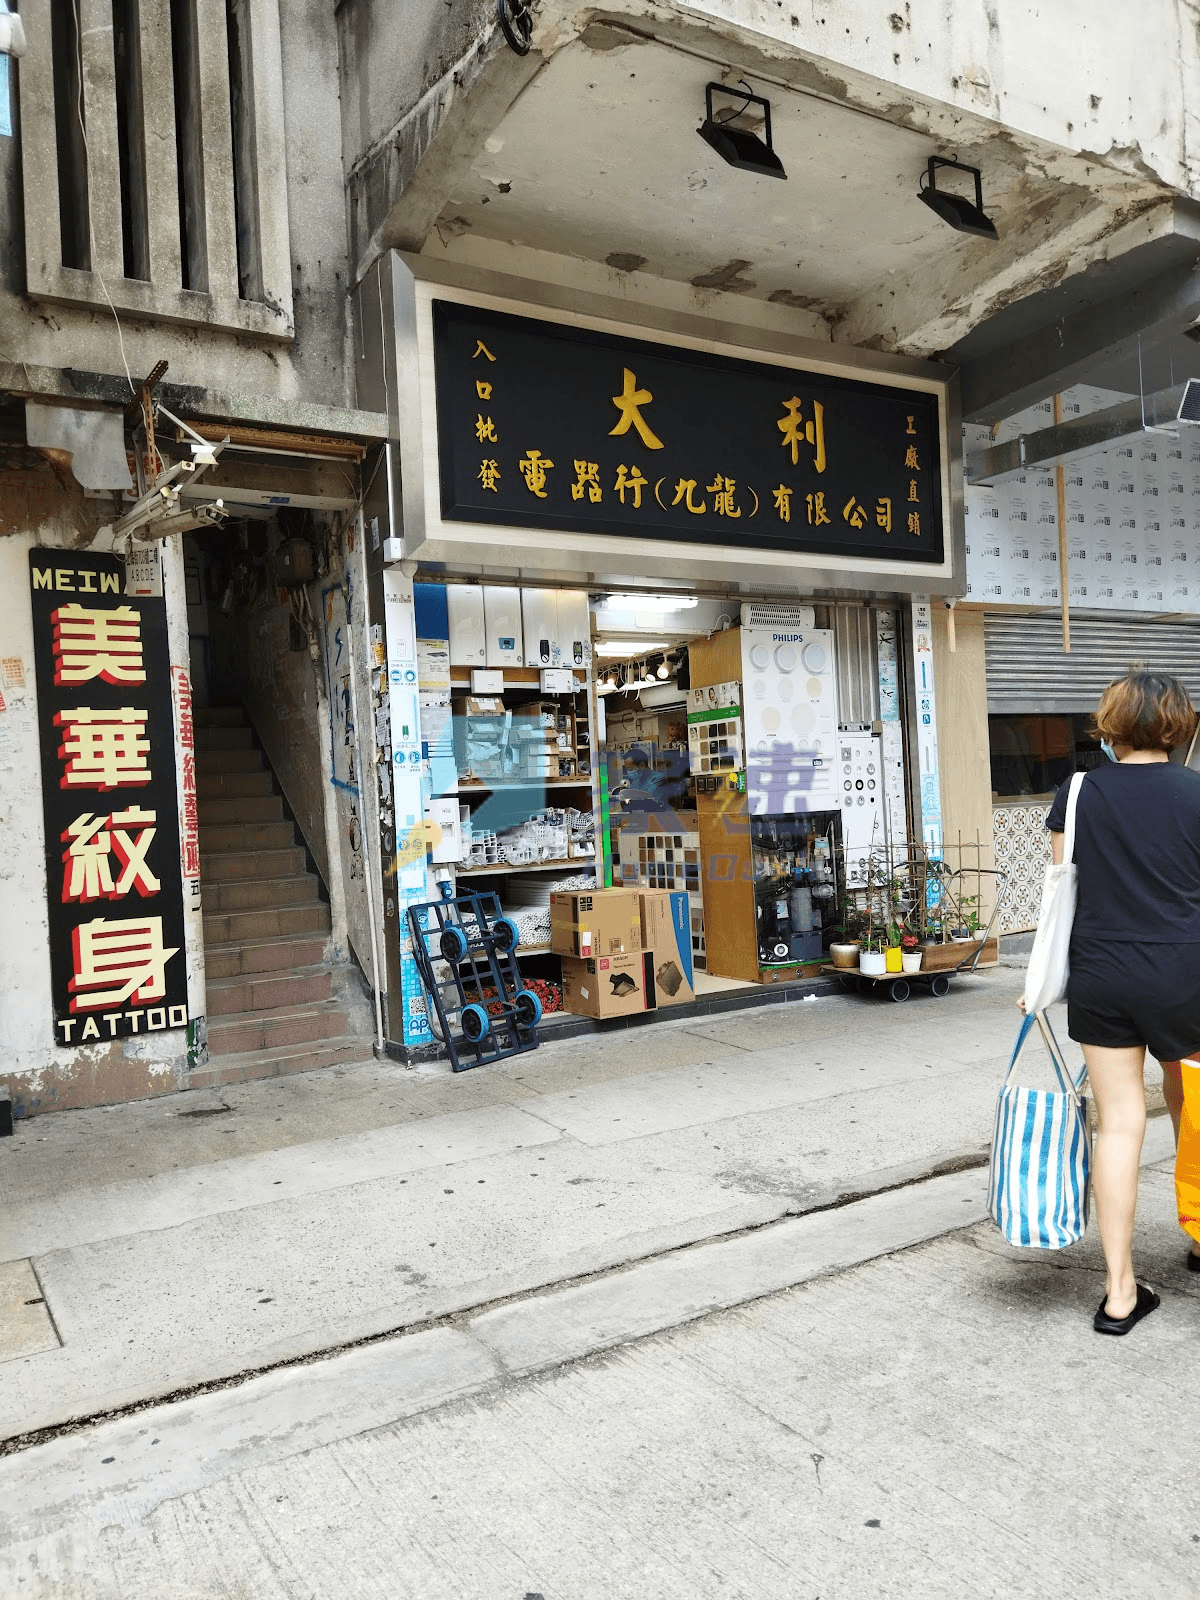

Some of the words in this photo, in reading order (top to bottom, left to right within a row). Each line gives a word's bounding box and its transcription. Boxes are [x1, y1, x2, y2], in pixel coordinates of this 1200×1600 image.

[471, 339, 501, 493] 入口批發
[608, 366, 827, 473] 大利
[904, 415, 921, 536] 工廠直銷
[32, 567, 127, 595] MEIW
[772, 633, 803, 643] PHILIPS
[51, 602, 180, 1012] 美華紋身
[57, 1004, 188, 1043] TATTOO
